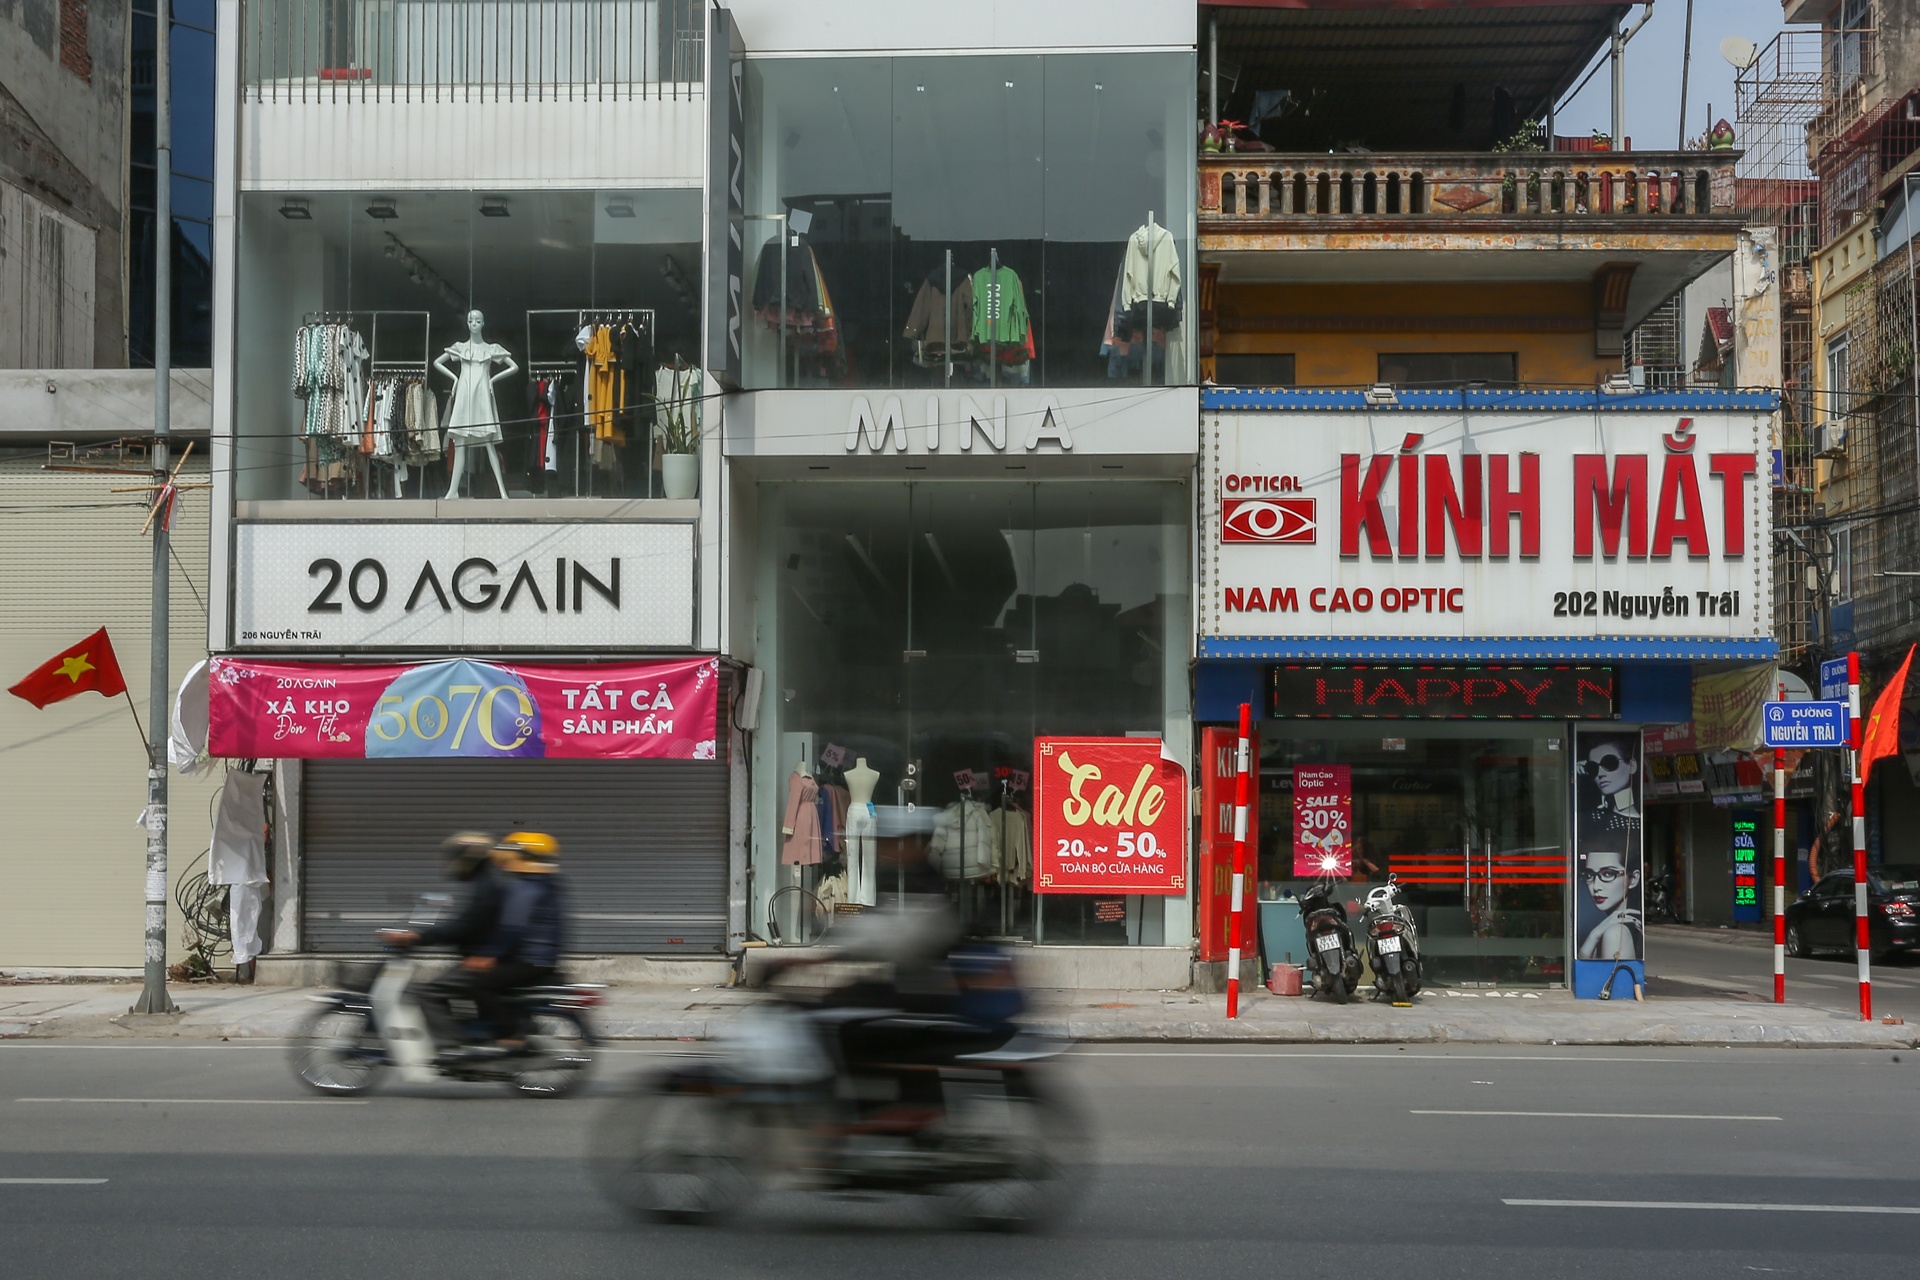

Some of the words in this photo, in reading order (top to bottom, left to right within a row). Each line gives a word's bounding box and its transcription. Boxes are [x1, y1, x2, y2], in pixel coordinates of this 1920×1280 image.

[845, 393, 1073, 451] MINA
[1225, 474, 1302, 492] OPTICAL
[1340, 432, 1540, 557] KÍNH
[1573, 417, 1757, 557] MẮT
[308, 558, 388, 612] 20
[404, 557, 621, 612] AGAIN
[1225, 587, 1299, 613] NAM
[1309, 587, 1374, 613] CAO
[1380, 587, 1463, 613] OPTIC
[1553, 591, 1597, 617] 202
[1602, 586, 1689, 620] Nguyễn
[1696, 590, 1740, 617] Trãi
[242, 631, 258, 640] 206
[561, 681, 623, 711] TẤT
[630, 683, 674, 711] CẢ
[1316, 678, 1553, 706] HAPPY
[266, 696, 297, 714] XẢ
[305, 700, 350, 714] KHO
[1791, 706, 1833, 718] ĐƯỜNG
[274, 714, 306, 740] Đón
[313, 712, 339, 742] Tết
[562, 714, 606, 734] SẢN
[612, 713, 673, 734] PHẨM
[1771, 720, 1809, 741] NGUYỄN
[1813, 722, 1835, 741] TRÃI
[1301, 771, 1318, 779] Nam
[1319, 771, 1334, 779] Cao
[1301, 779, 1324, 788] Optic
[1058, 751, 1166, 826] Sale
[1305, 795, 1338, 807] SALE
[1300, 809, 1347, 829] 30%
[1057, 839, 1092, 858] 20%
[1117, 831, 1167, 858] 50%
[1734, 831, 1755, 848] SỬA
[1060, 861, 1090, 873] TOÀN
[1092, 862, 1107, 875] BỘ
[1109, 860, 1131, 873] CỬA
[1134, 862, 1164, 874] HÀNG
[1214, 853, 1253, 896] ĐỒG
